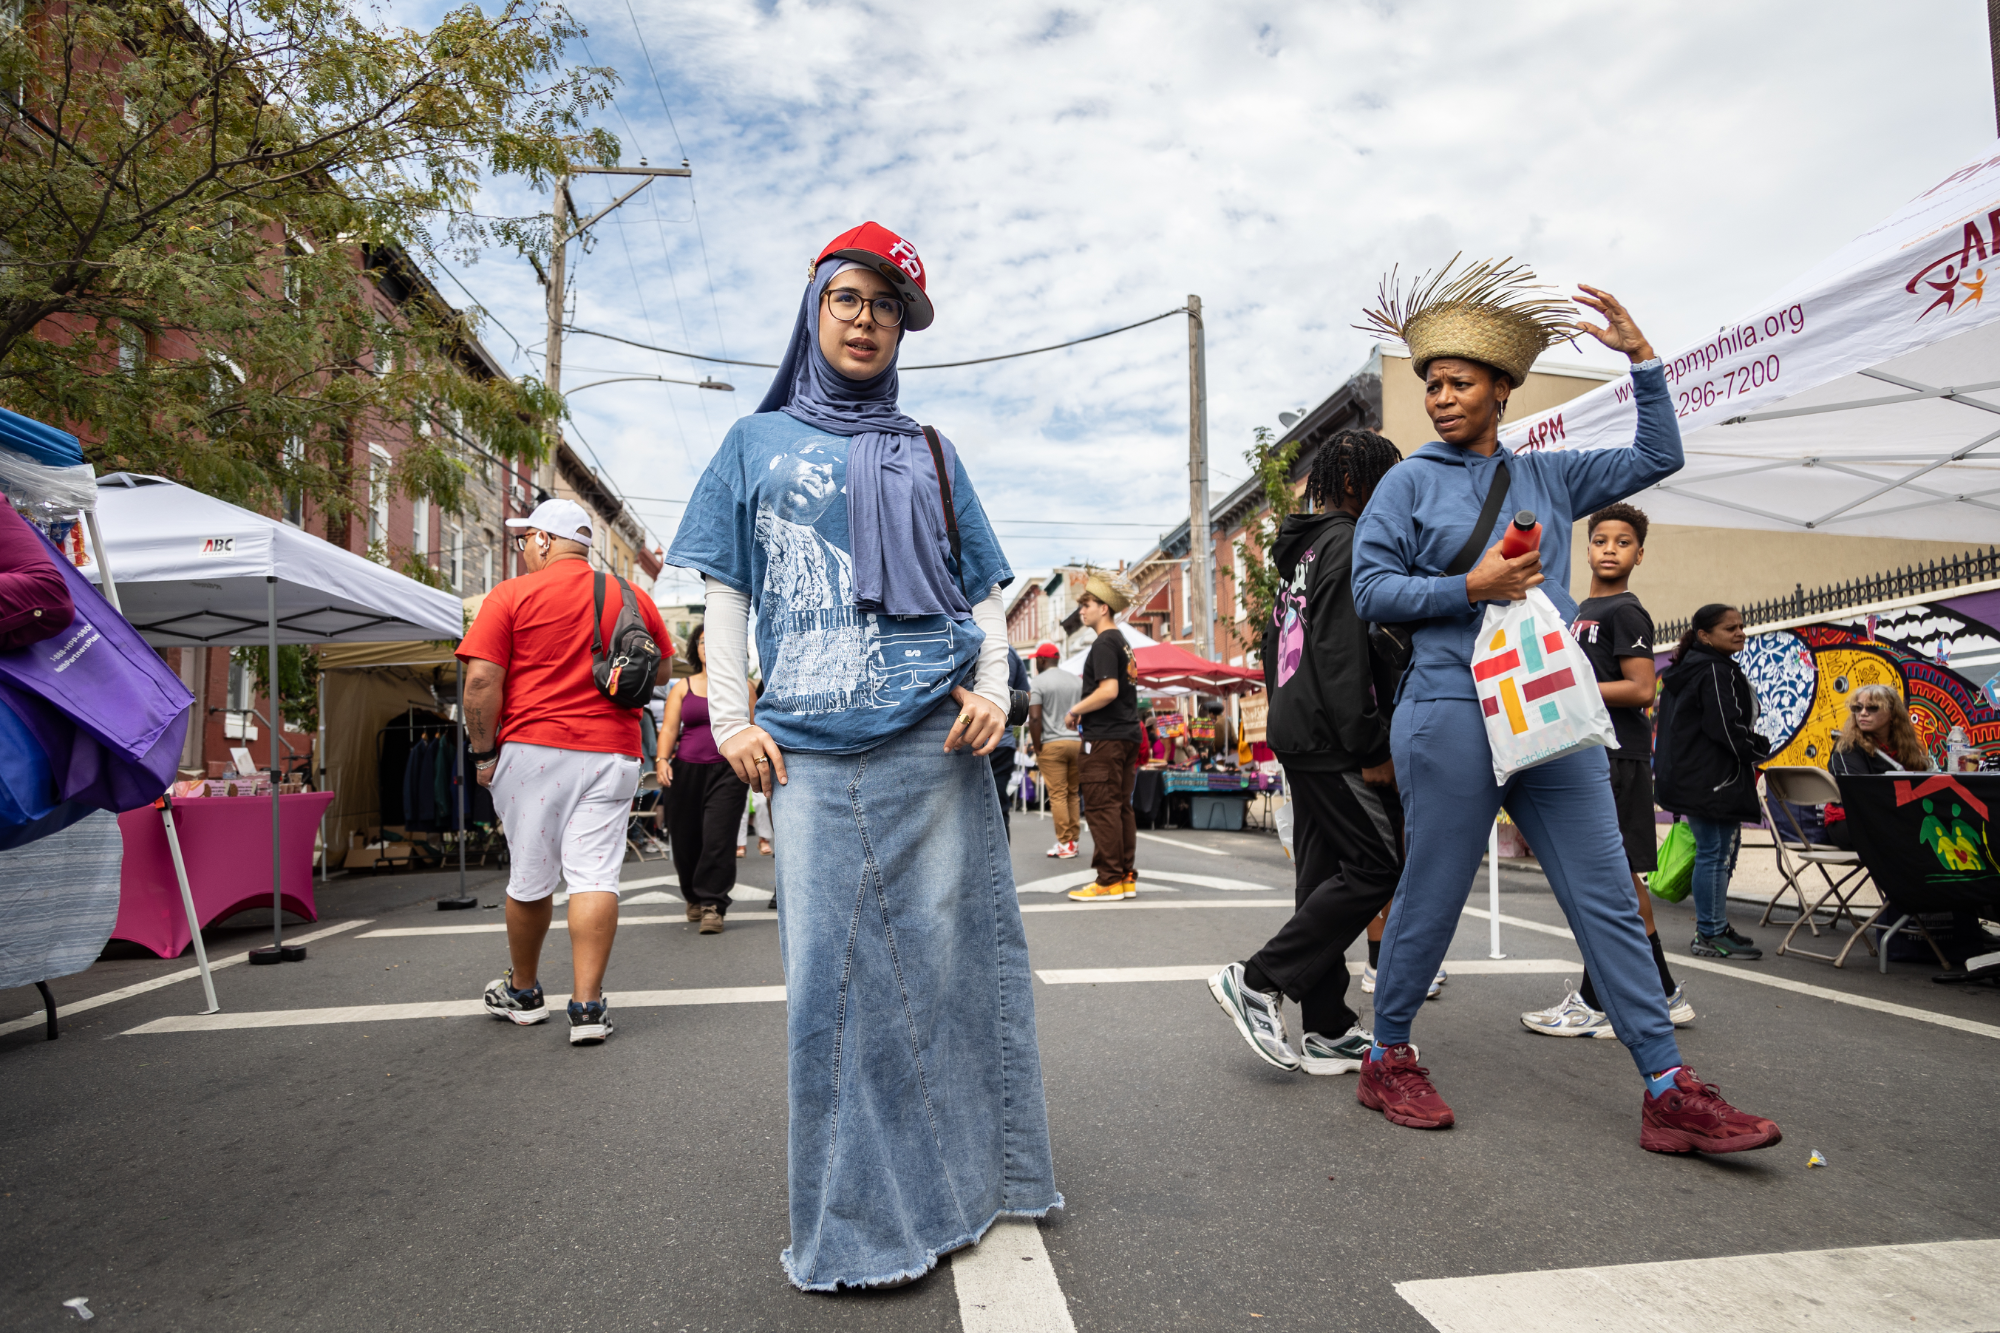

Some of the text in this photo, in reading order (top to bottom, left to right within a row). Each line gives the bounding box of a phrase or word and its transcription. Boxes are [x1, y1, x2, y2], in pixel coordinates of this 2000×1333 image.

[1528, 412, 1566, 452] APM
[202, 538, 233, 552] ABC
[820, 605, 863, 631] DEATH
